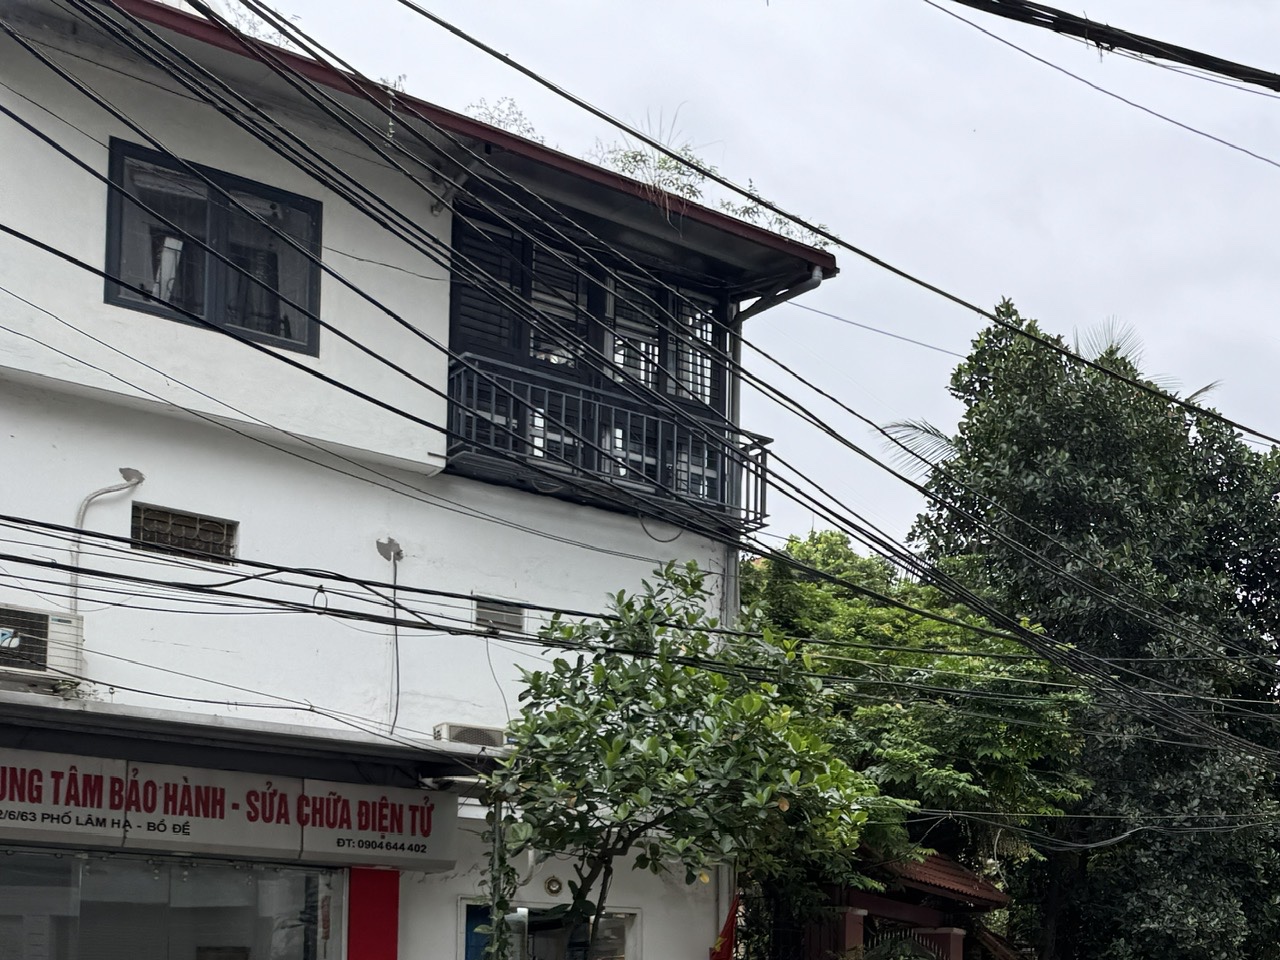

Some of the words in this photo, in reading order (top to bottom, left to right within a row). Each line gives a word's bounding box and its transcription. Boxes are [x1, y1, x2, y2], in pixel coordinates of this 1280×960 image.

[51, 765, 104, 809] TÂM
[109, 767, 157, 814] BẢO
[163, 775, 225, 820] HÀNH
[231, 802, 240, 810] -
[246, 781, 290, 825] SỬA
[296, 791, 352, 830] CHỮA
[357, 796, 403, 839] ĐIỆN
[409, 796, 435, 838] TỬ
[41, 811, 72, 825] PHỐ
[76, 814, 107, 828] LÂM
[111, 817, 133, 833] HẠ
[336, 838, 355, 848] ĐT:
